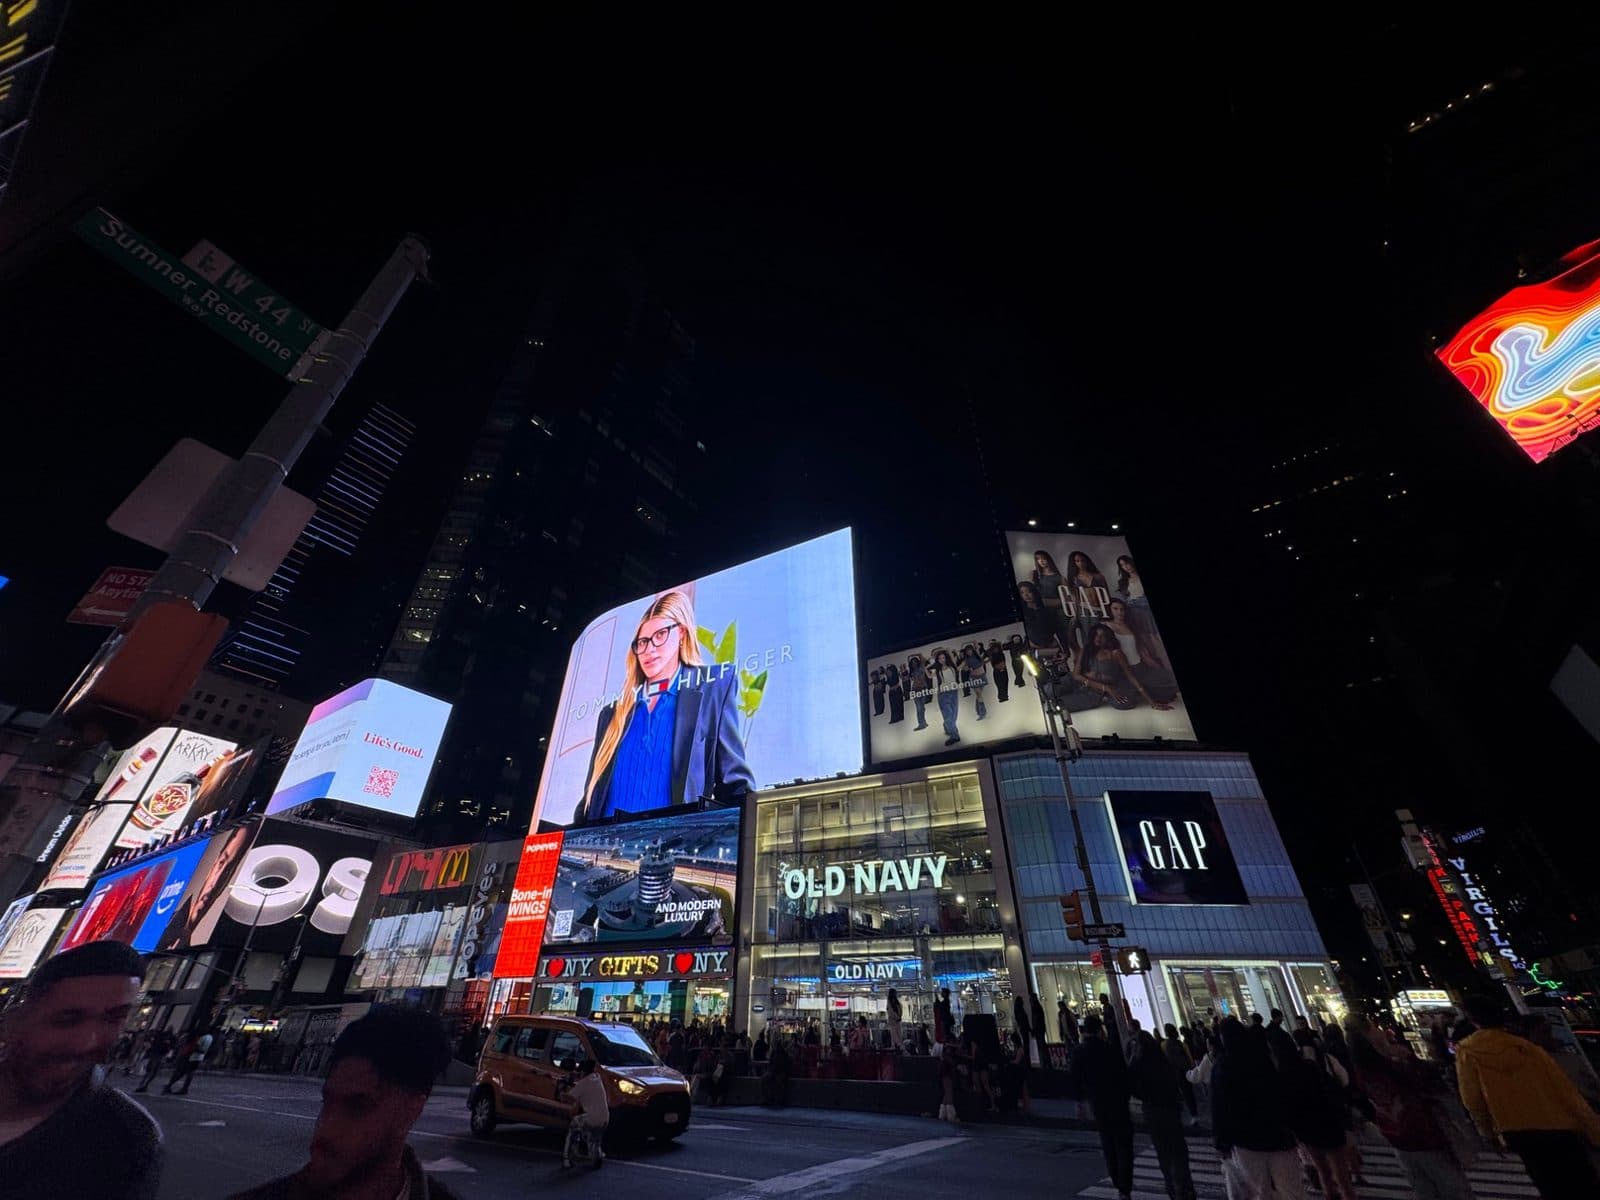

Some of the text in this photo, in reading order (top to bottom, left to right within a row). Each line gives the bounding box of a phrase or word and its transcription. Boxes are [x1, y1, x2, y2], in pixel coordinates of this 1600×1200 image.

[100, 220, 292, 361] Sumner Redstone
[223, 267, 254, 294] W
[255, 295, 291, 326] 44
[105, 573, 127, 585] NO
[1057, 584, 1110, 618] GAP
[569, 644, 794, 720] TOMMY HILFIGER
[909, 687, 937, 700] Better
[173, 741, 214, 762] ARKAY
[364, 731, 391, 749] Life's
[393, 741, 424, 758] Good.
[1139, 819, 1209, 870] GAP
[784, 865, 846, 900] OLD
[854, 855, 947, 895] NAVY
[510, 886, 553, 902] Bone-in
[508, 900, 546, 917] WINGS
[655, 898, 722, 913] AND MODERN
[664, 910, 704, 923] LUXURY
[599, 955, 659, 977] GIFTS
[666, 953, 674, 974] I
[835, 962, 905, 980] OLD NAVY
